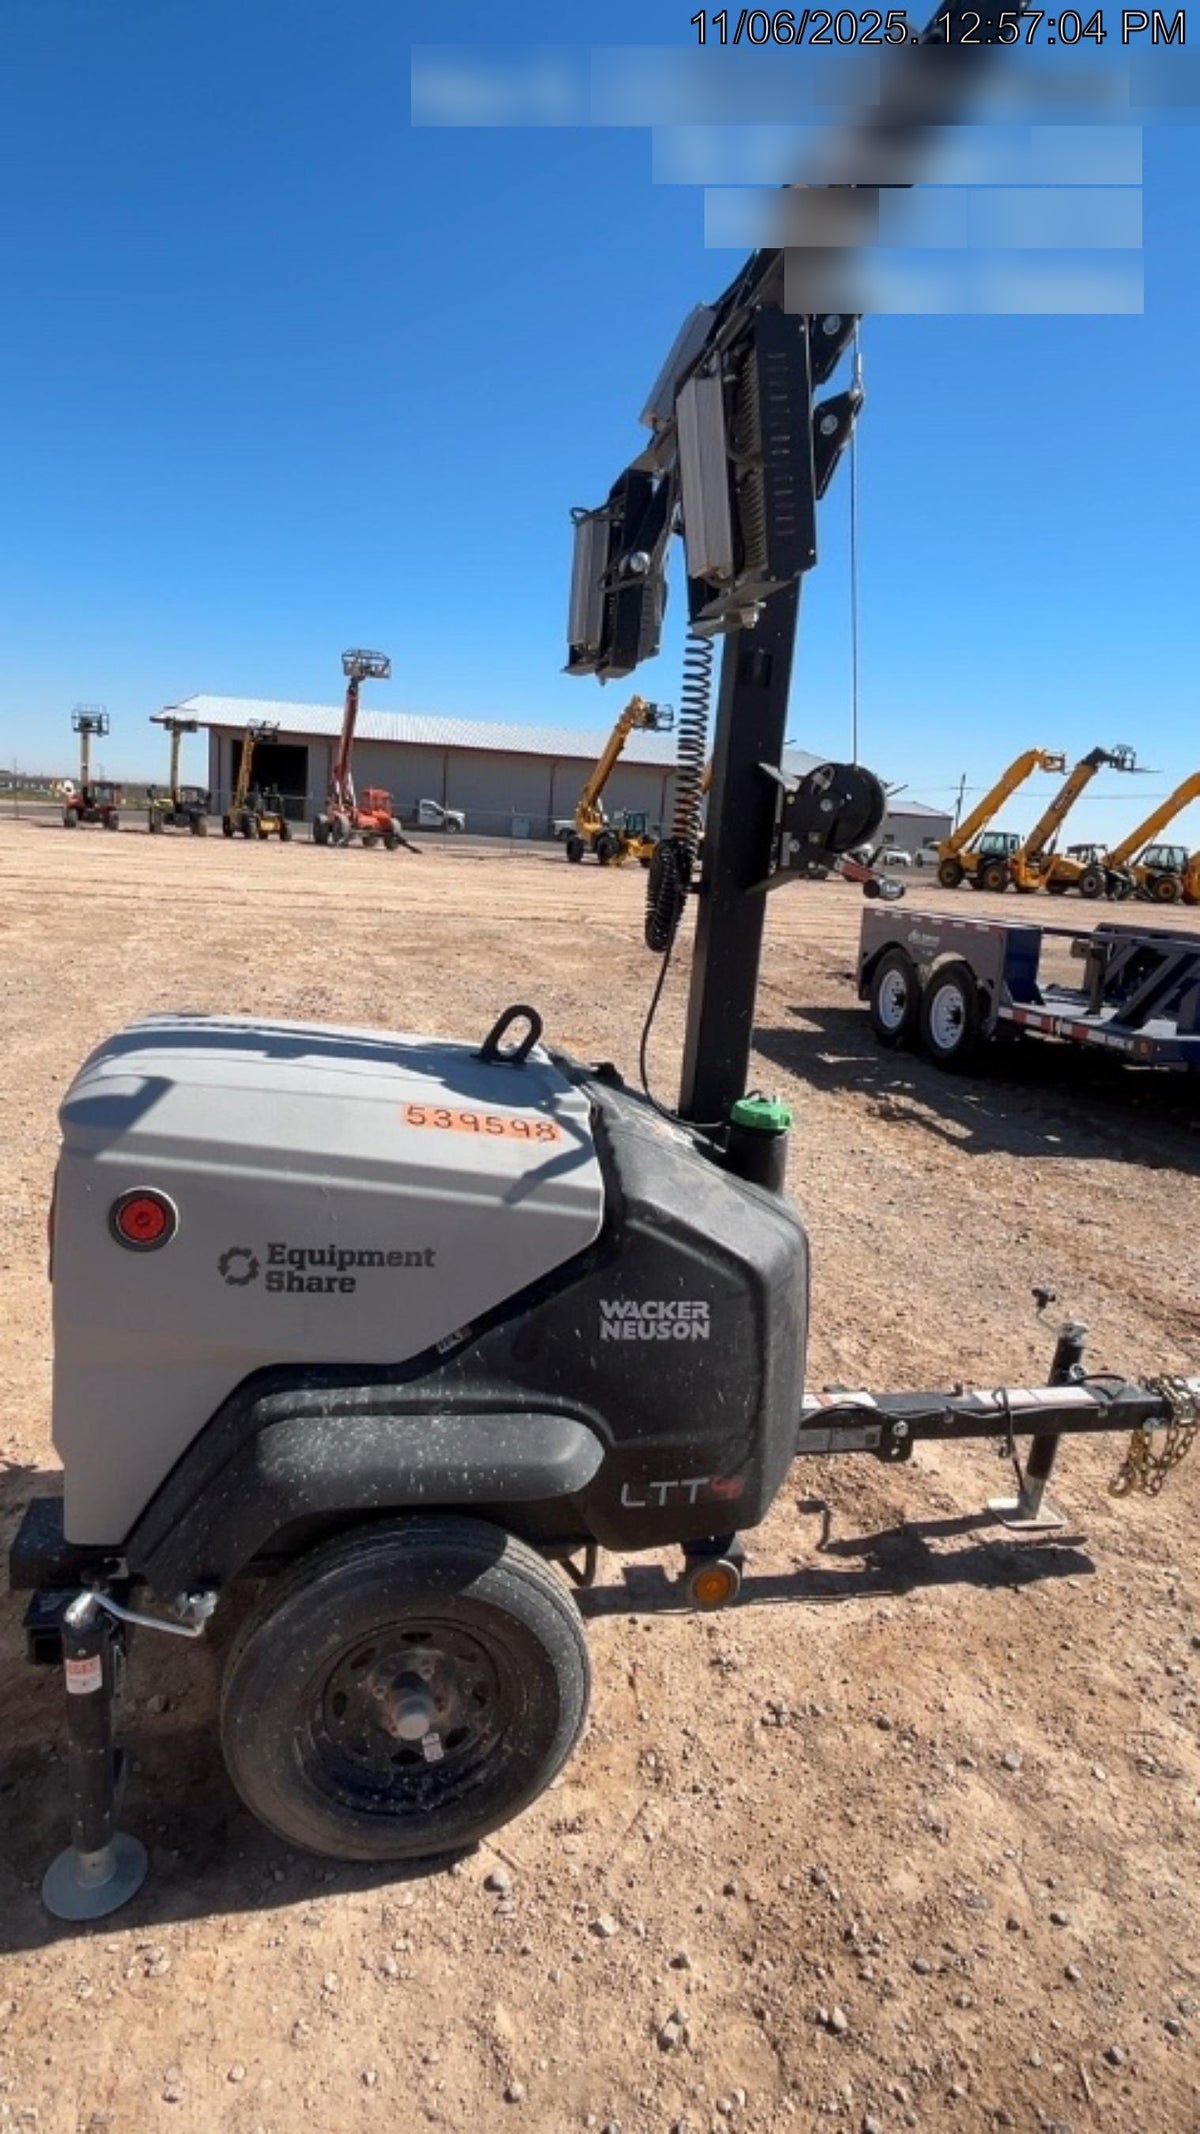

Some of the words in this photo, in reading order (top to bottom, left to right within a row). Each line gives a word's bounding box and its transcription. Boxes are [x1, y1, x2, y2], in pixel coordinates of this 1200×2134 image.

[407, 1105, 556, 1142] 539598
[266, 1242, 436, 1271] Equipment
[265, 1270, 356, 1293] Share
[600, 1300, 710, 1319] WACKER
[600, 1320, 710, 1340] NEUSON
